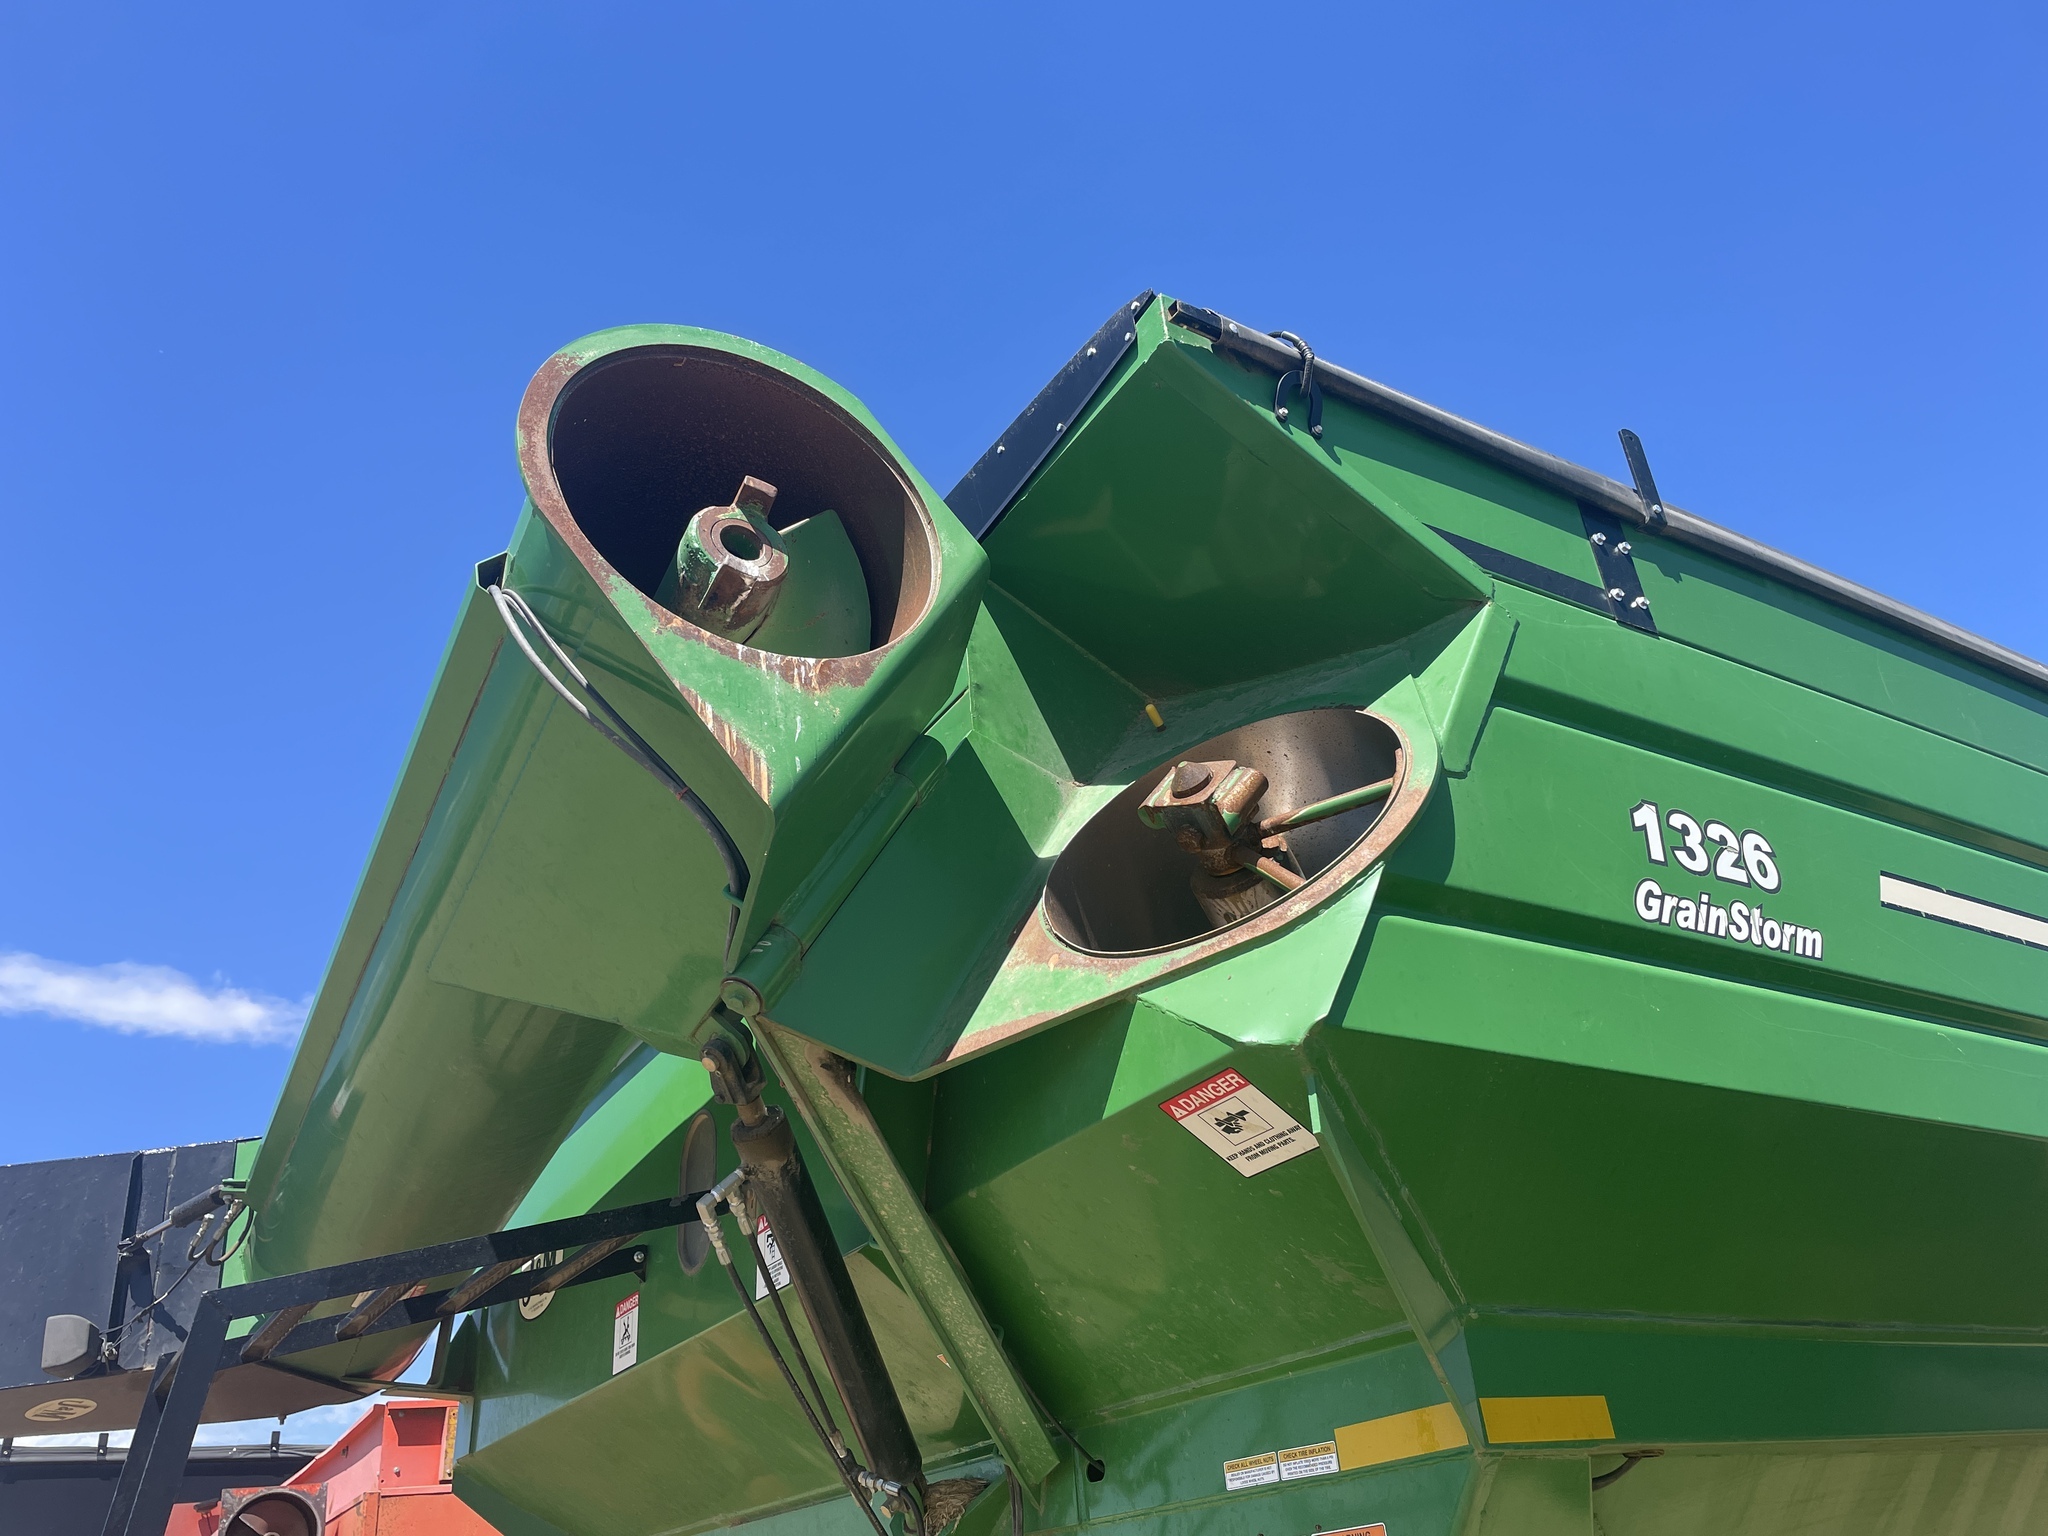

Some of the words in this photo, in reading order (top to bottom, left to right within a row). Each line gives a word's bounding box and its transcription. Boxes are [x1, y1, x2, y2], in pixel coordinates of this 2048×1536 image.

[1630, 800, 1781, 893] 1326
[1634, 878, 1823, 960] GrainStorm
[1178, 1073, 1246, 1112] DANGER
[1226, 1153, 1238, 1162] KEEP
[1237, 1146, 1255, 1156] HANDS
[1254, 1141, 1265, 1149] AND
[1264, 1131, 1288, 1144] CLOTHING
[1286, 1124, 1302, 1134] AWAY
[1245, 1153, 1261, 1162] FROM
[1258, 1144, 1279, 1156] MOVING
[620, 1294, 639, 1312] DANGER
[1309, 1446, 1331, 1454] INFLATION
